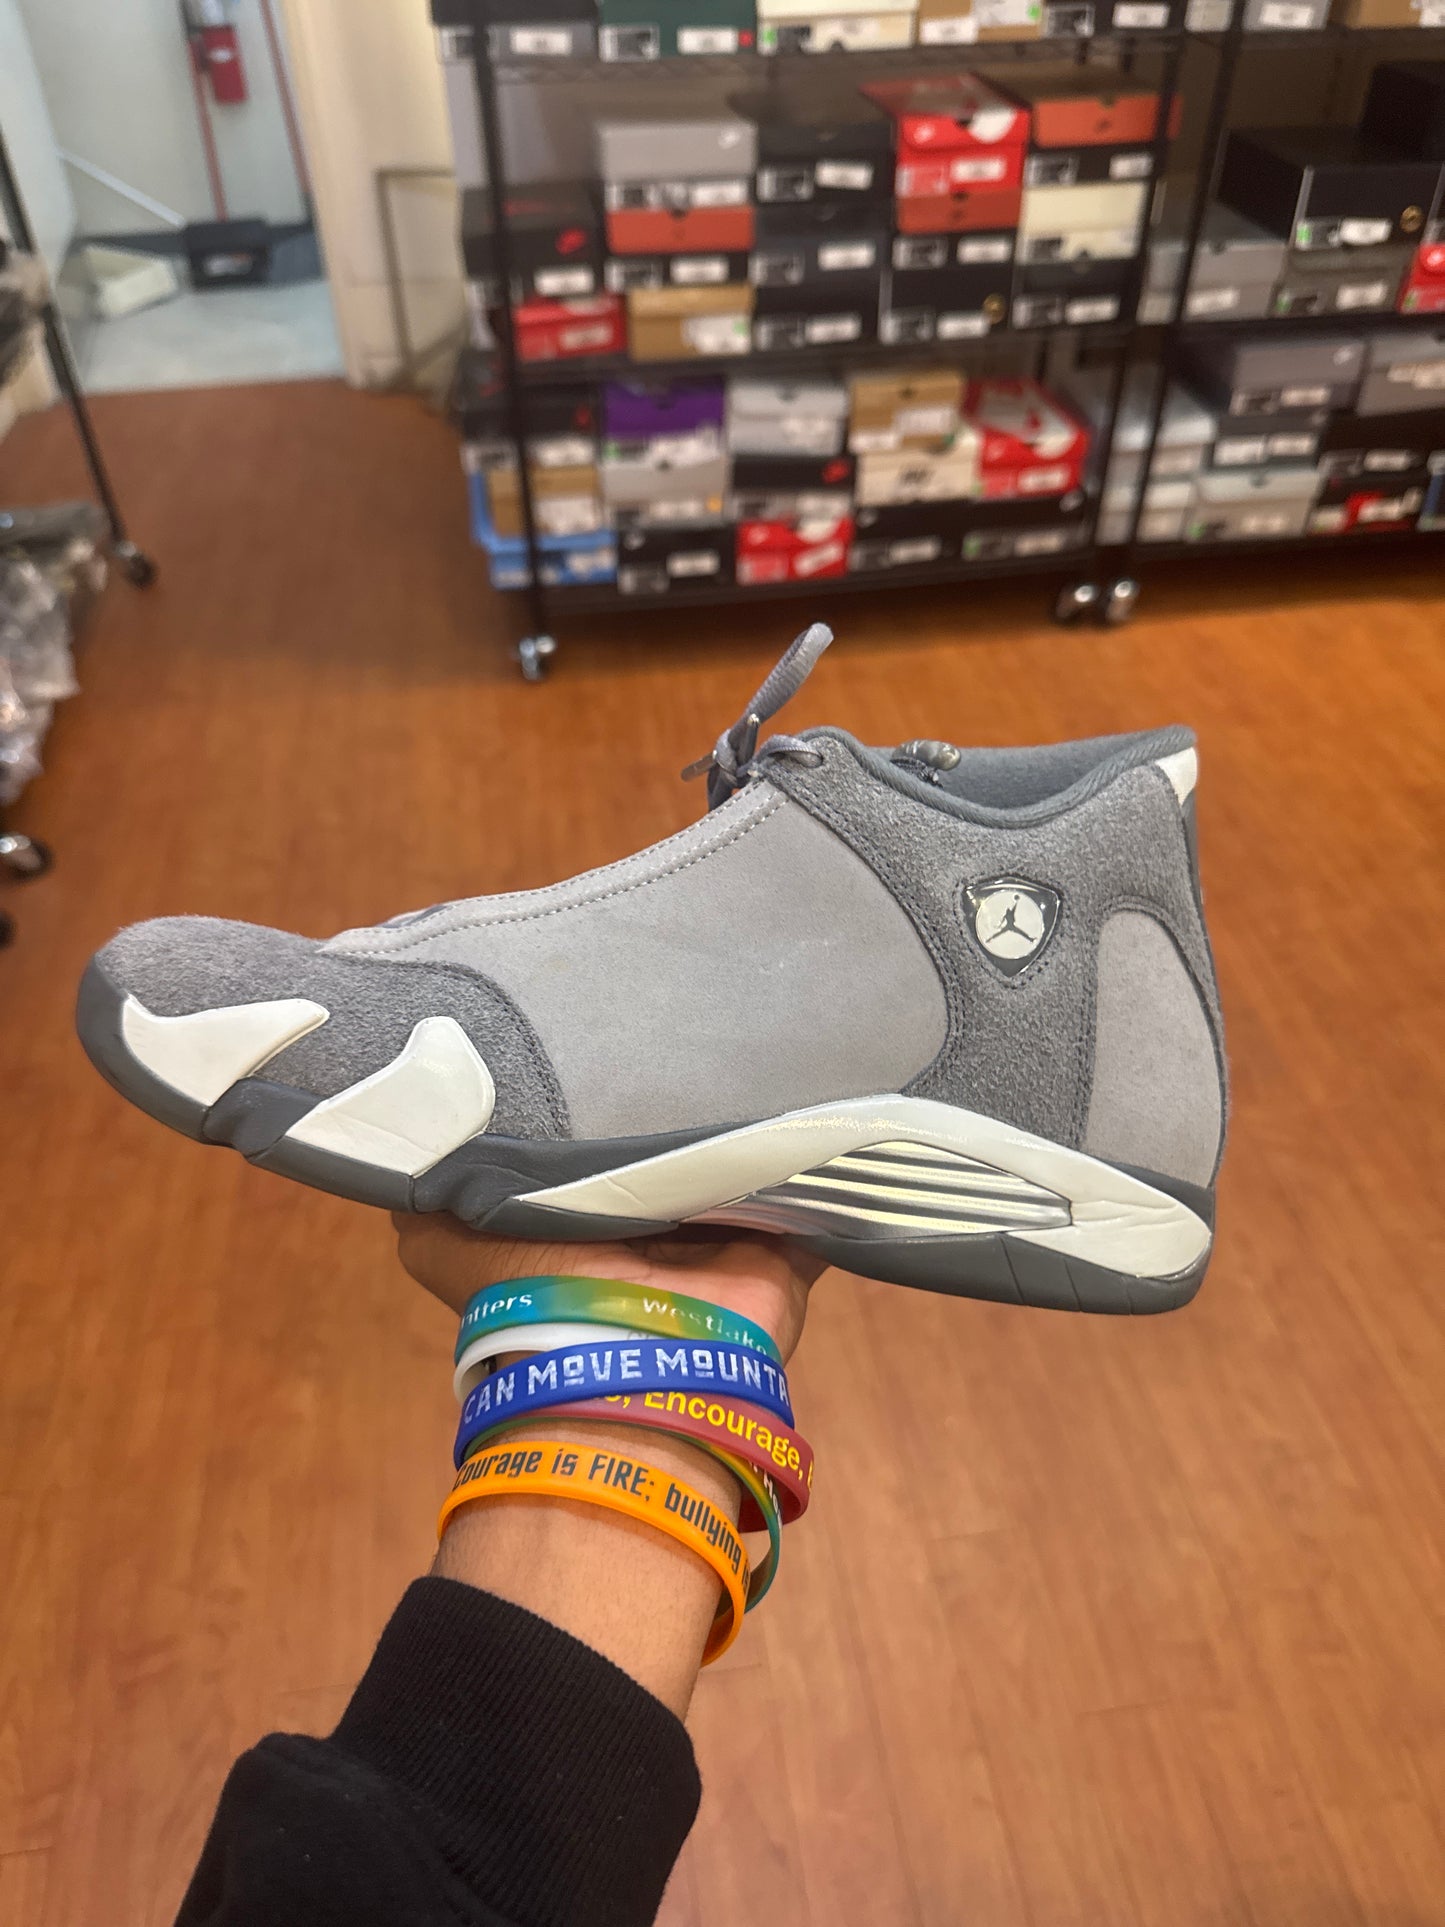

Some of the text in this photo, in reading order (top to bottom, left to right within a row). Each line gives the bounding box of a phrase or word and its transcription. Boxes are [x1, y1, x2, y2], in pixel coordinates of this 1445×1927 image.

[463, 1372, 515, 1424] CAN
[527, 1348, 643, 1396] MOVE
[644, 1392, 803, 1480] Encourage,
[453, 1450, 543, 1492] Courage
[551, 1448, 579, 1476] is
[588, 1453, 654, 1502] FIRE;
[664, 1482, 742, 1575] bullying
